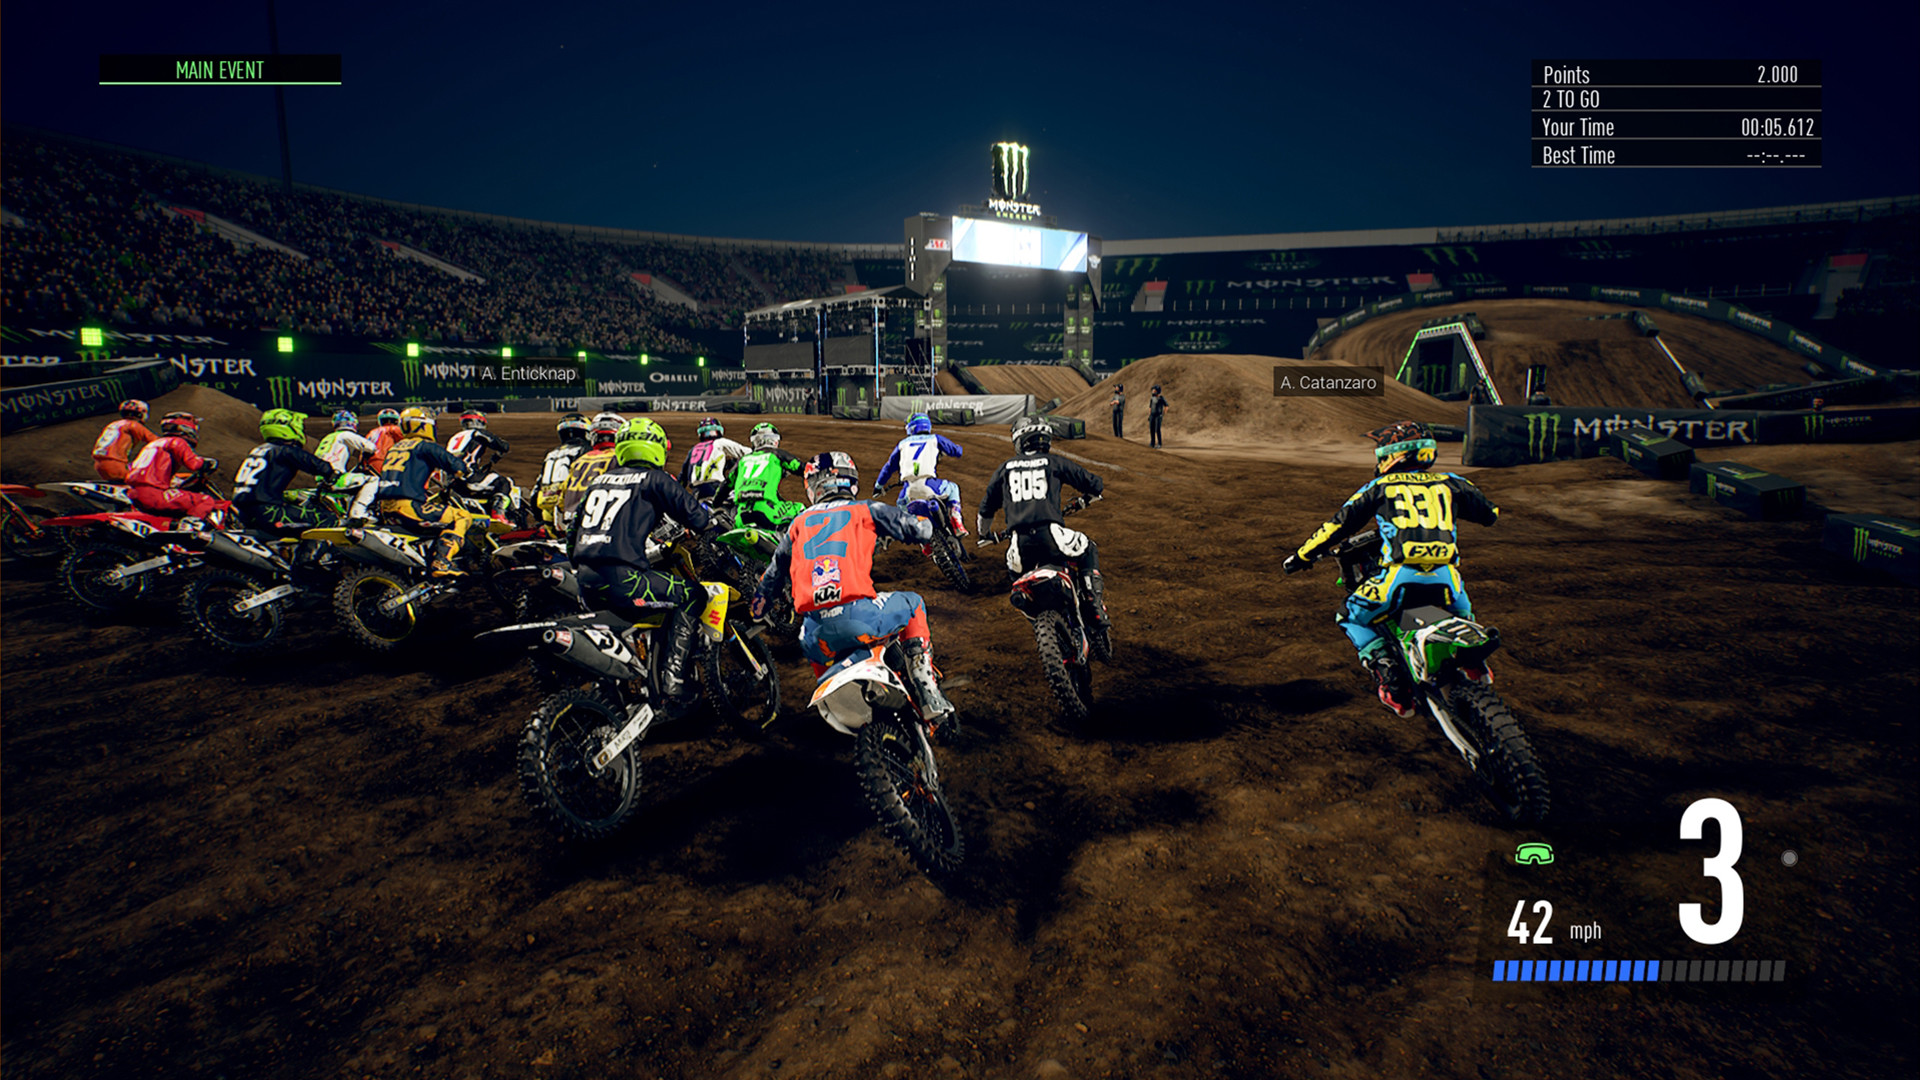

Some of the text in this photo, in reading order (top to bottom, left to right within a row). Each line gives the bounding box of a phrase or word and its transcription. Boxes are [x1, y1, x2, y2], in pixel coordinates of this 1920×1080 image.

[988, 198, 1041, 216] MONSTER
[1226, 275, 1397, 290] MONSTER
[297, 377, 395, 399] MONSTER
[598, 379, 647, 394] MONSTER
[382, 450, 412, 472] 22
[690, 445, 714, 464] 51
[909, 442, 927, 460] 7
[234, 457, 268, 485] 62
[742, 460, 769, 479] 17
[1008, 469, 1049, 503] 805
[581, 488, 632, 531] 97
[1385, 483, 1453, 531] 330
[803, 510, 851, 560] 2
[814, 585, 843, 606] KTM
